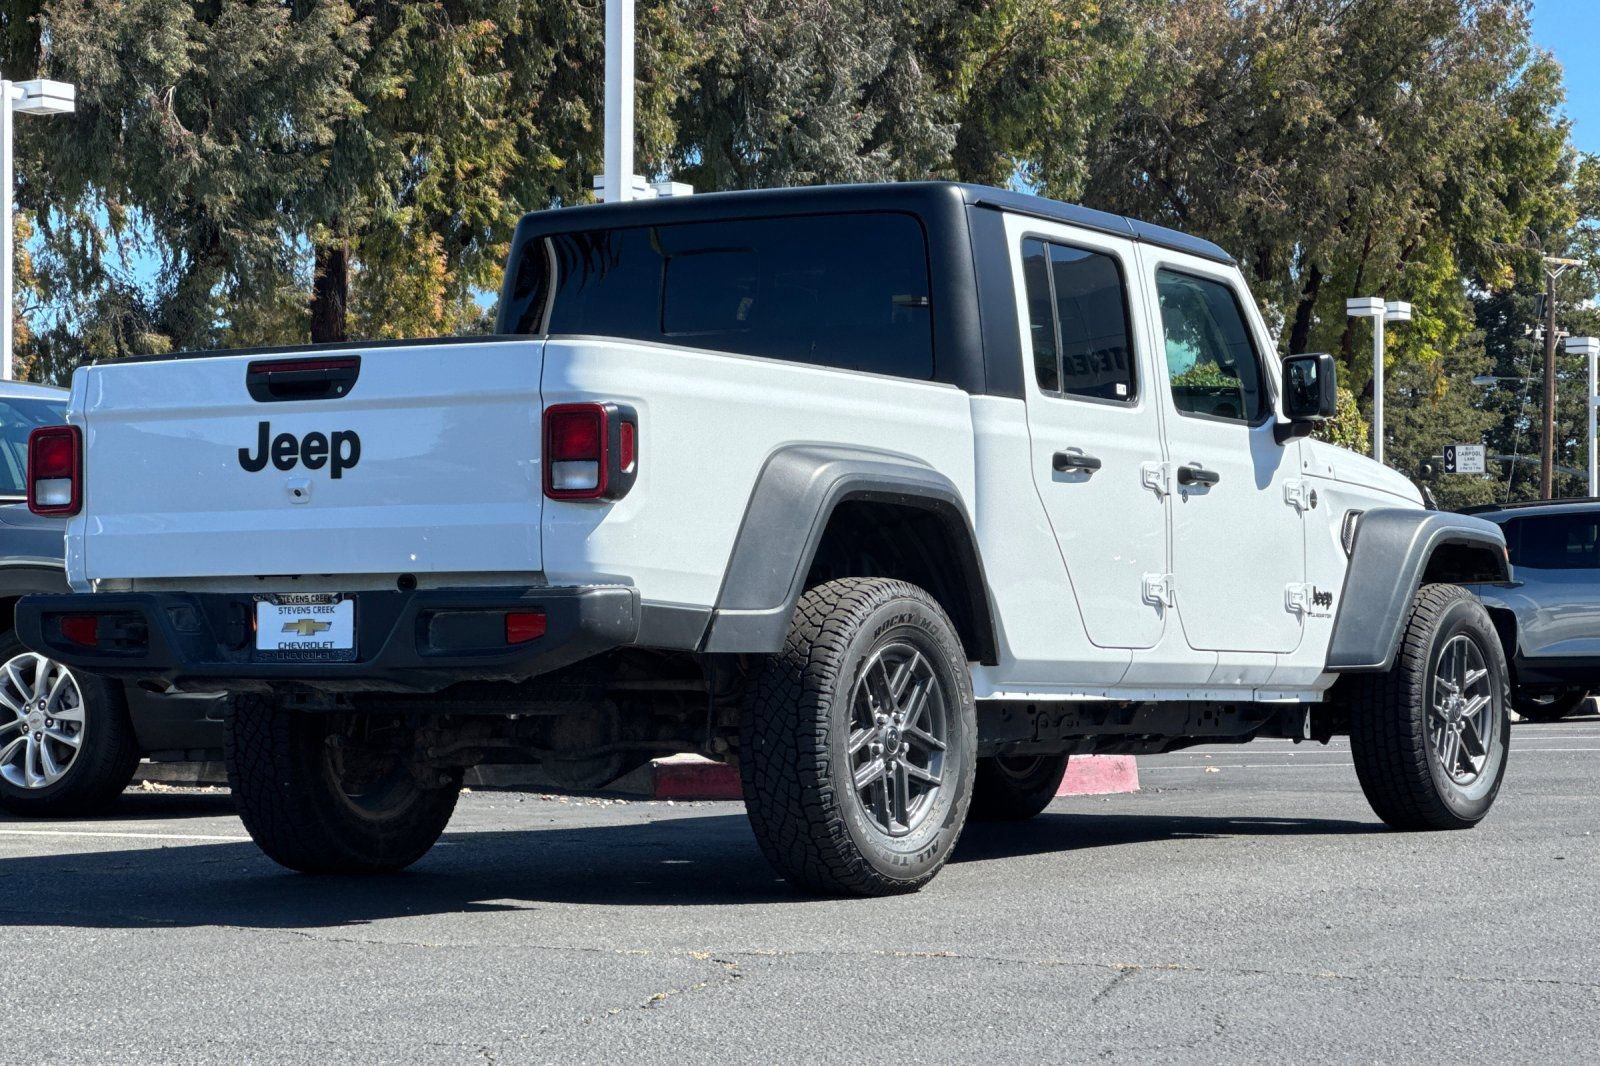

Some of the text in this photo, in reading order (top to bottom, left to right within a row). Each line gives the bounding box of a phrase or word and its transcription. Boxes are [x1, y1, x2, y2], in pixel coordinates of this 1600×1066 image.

[238, 421, 361, 479] Jeep
[279, 594, 333, 604] STEVENS CREEK
[278, 605, 336, 615] STEVENS CREEK
[873, 613, 914, 640] ROCKY
[278, 641, 335, 650] CHEVROLET
[917, 840, 939, 863] ALL
